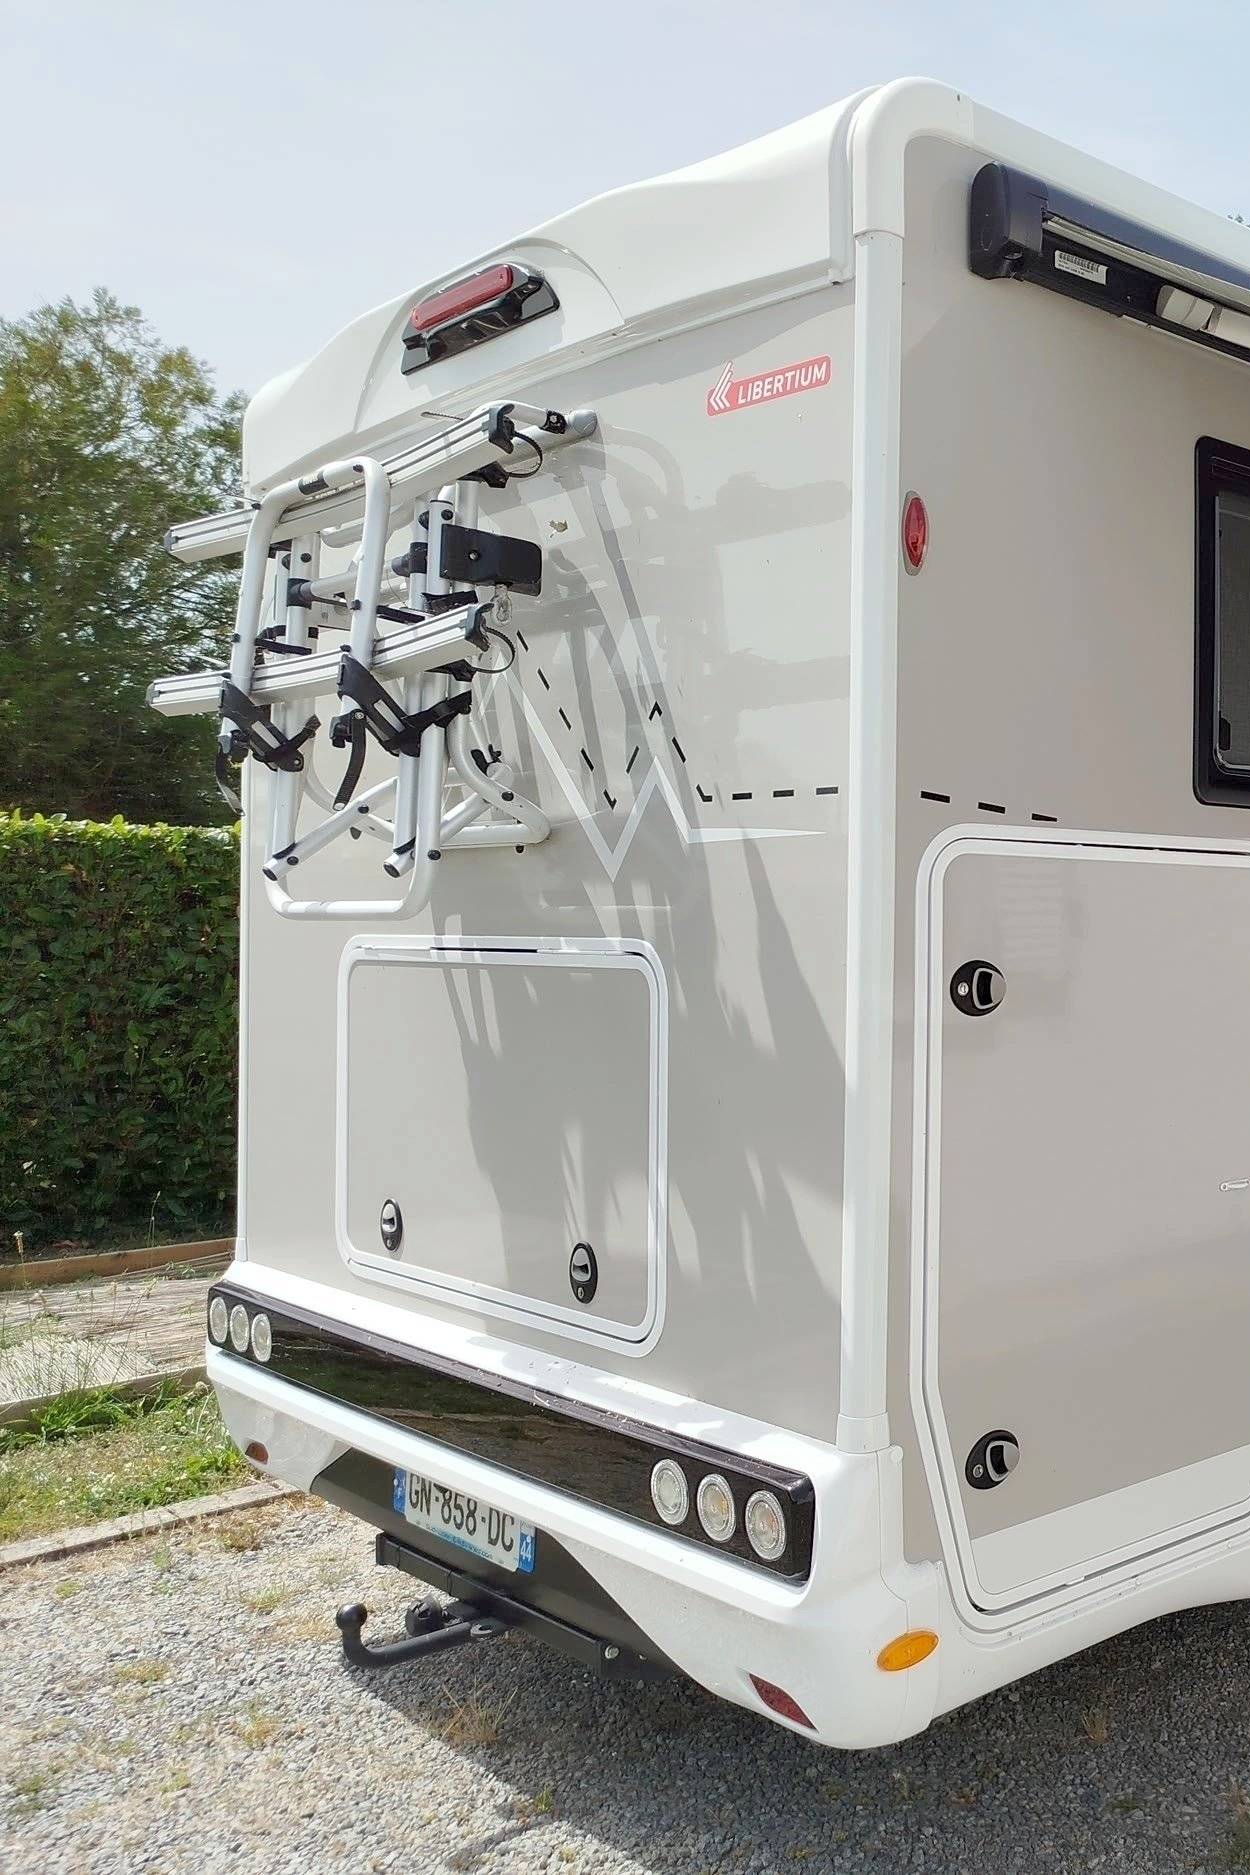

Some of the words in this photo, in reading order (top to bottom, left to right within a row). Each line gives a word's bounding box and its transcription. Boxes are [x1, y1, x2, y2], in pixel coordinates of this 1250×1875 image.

[737, 361, 827, 405] LIBERTIUM
[409, 1472, 515, 1553] GN-858-DC
[520, 1540, 532, 1562] 44
